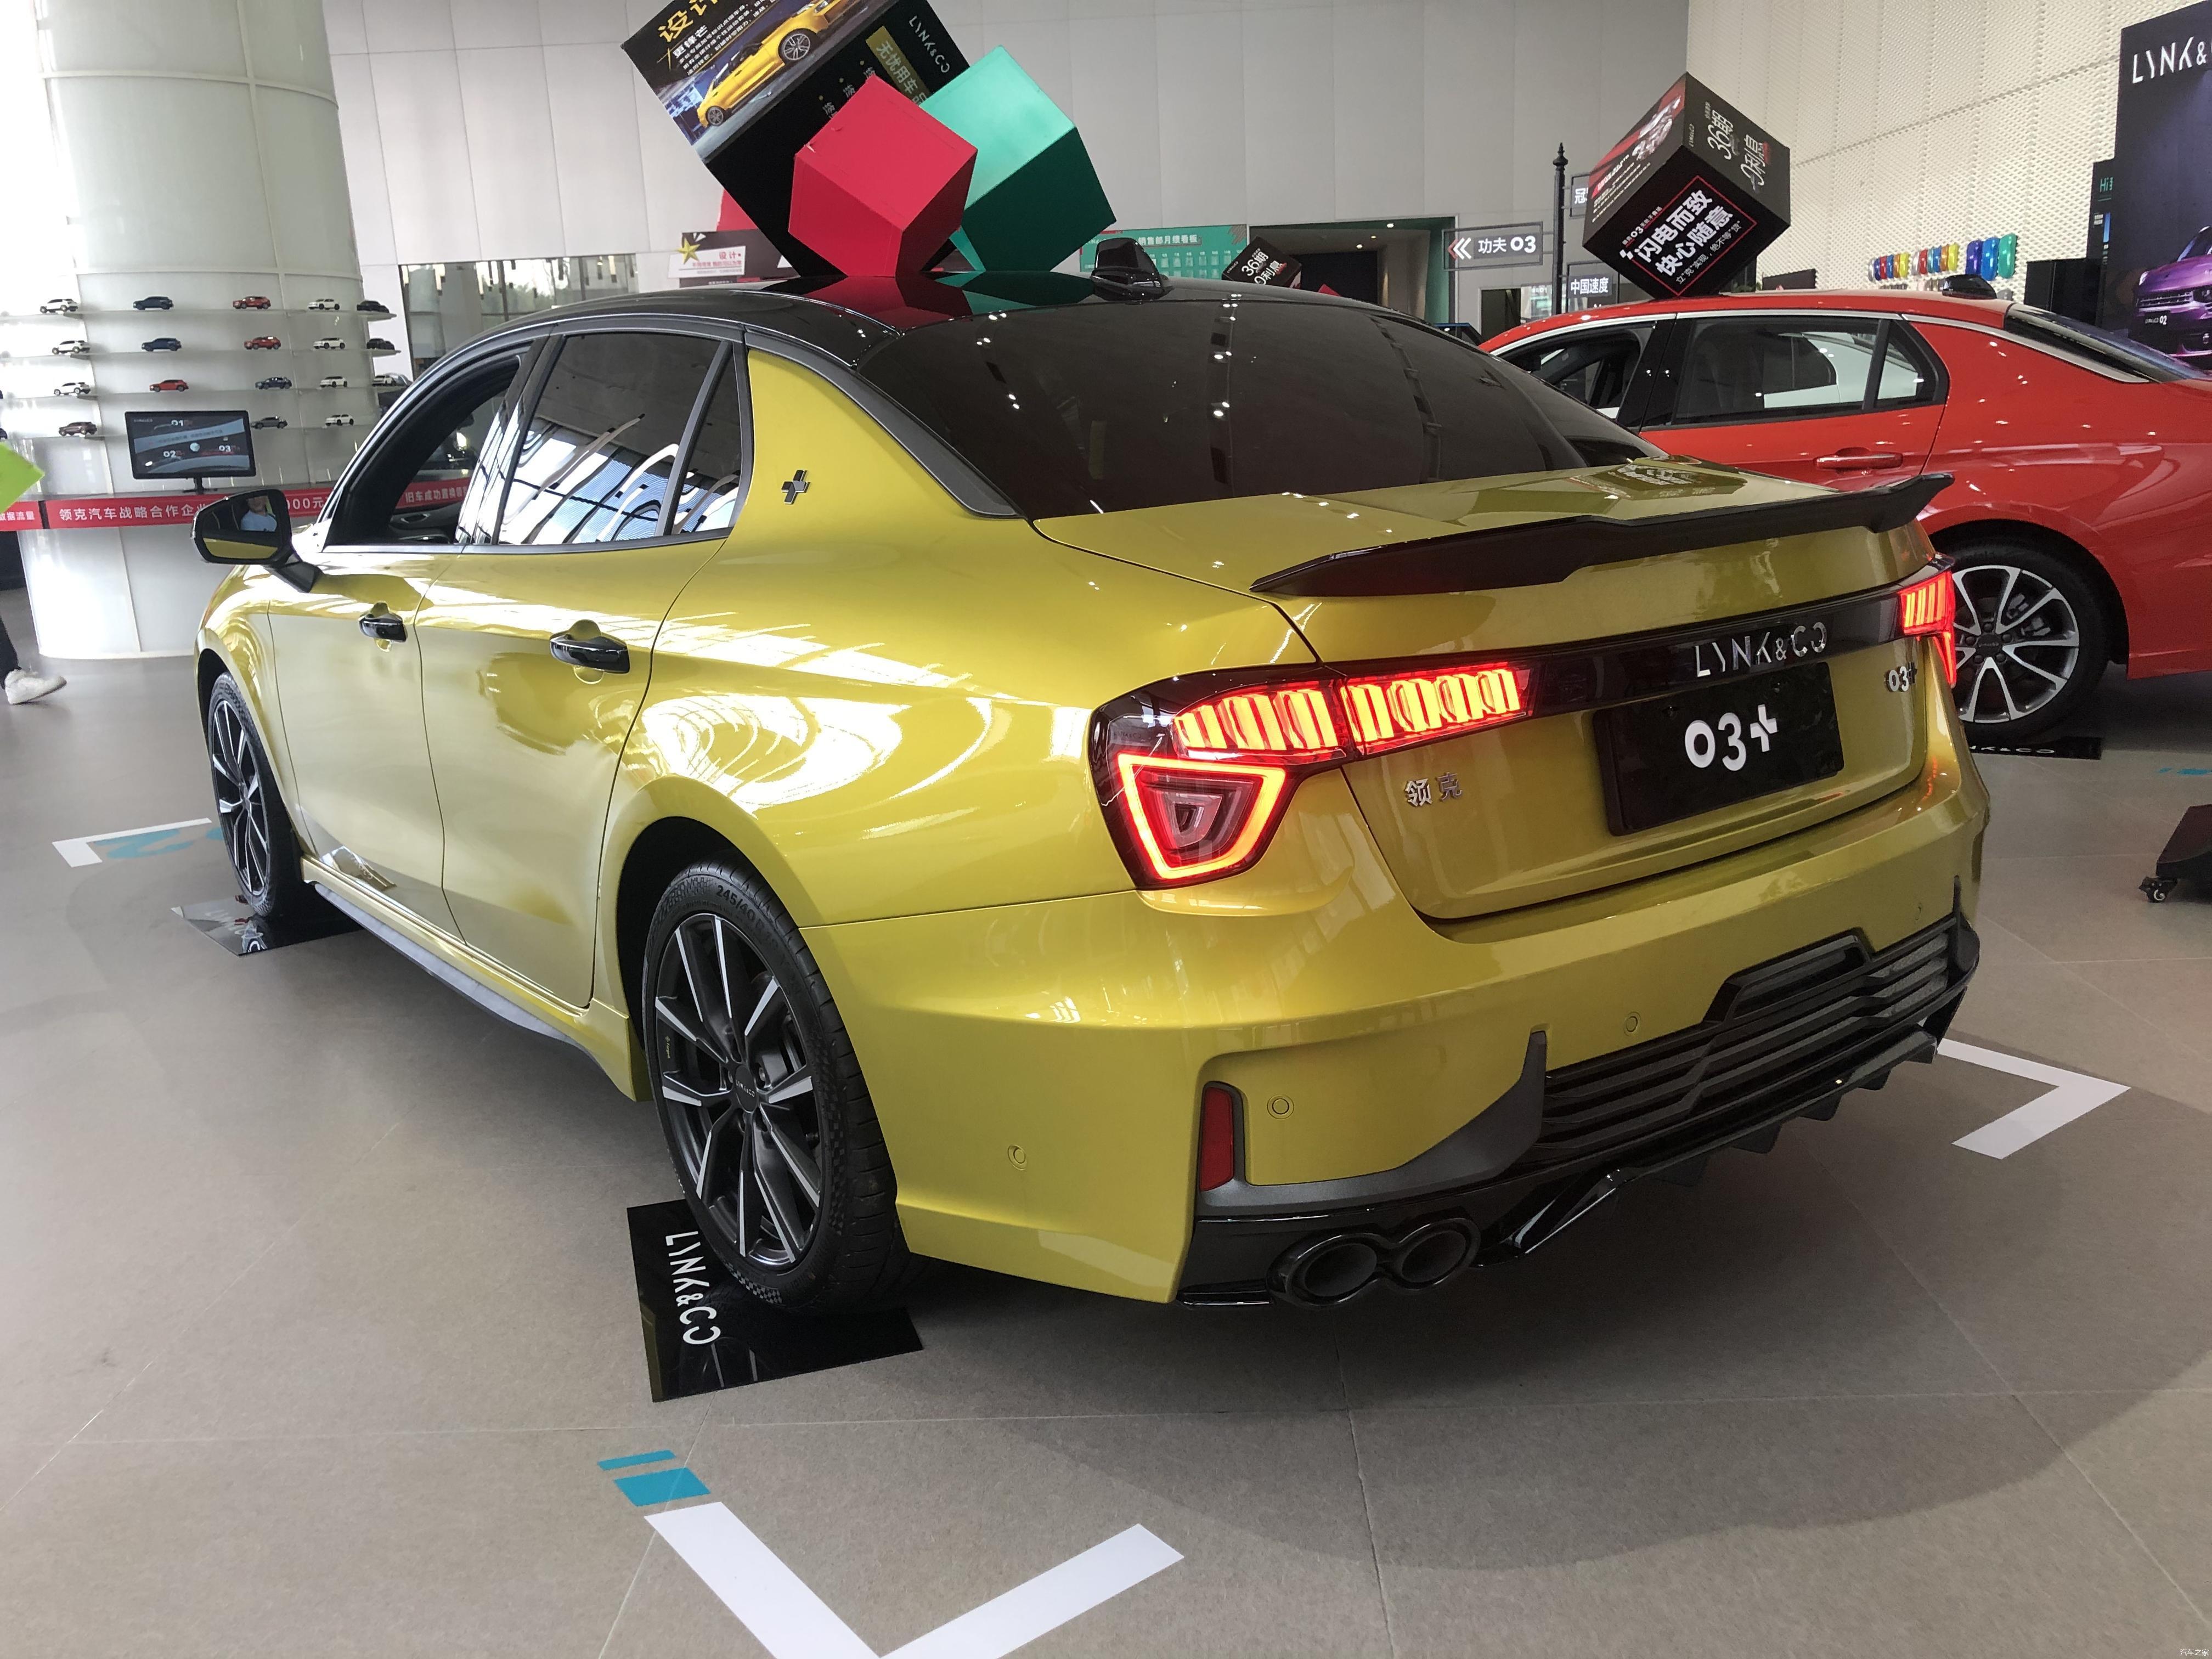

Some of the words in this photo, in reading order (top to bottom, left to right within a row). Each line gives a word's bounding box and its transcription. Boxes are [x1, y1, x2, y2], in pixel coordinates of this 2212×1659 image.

[673, 25, 708, 59] 更锋芒
[909, 15, 950, 73] LYNK&CO
[2132, 36, 2212, 84] LYNK&
[876, 40, 918, 94] 无忧用车
[1707, 110, 1734, 160] 36期
[1740, 134, 1766, 186] 0利息
[1574, 187, 1589, 205] 冠
[1477, 237, 1507, 254] 功夫
[1510, 235, 1536, 253] 03
[1634, 190, 1713, 263] 闪电而致
[1655, 205, 1733, 276] 快心随意
[1241, 251, 1269, 276] 36期
[1570, 276, 1609, 295] 中国速度
[2159, 315, 2167, 325] 02
[1695, 622, 1827, 678] LYNK&CO
[1404, 771, 1464, 807] 领克
[716, 884, 756, 921] 245/40
[665, 1231, 722, 1345] LYNK&CO
